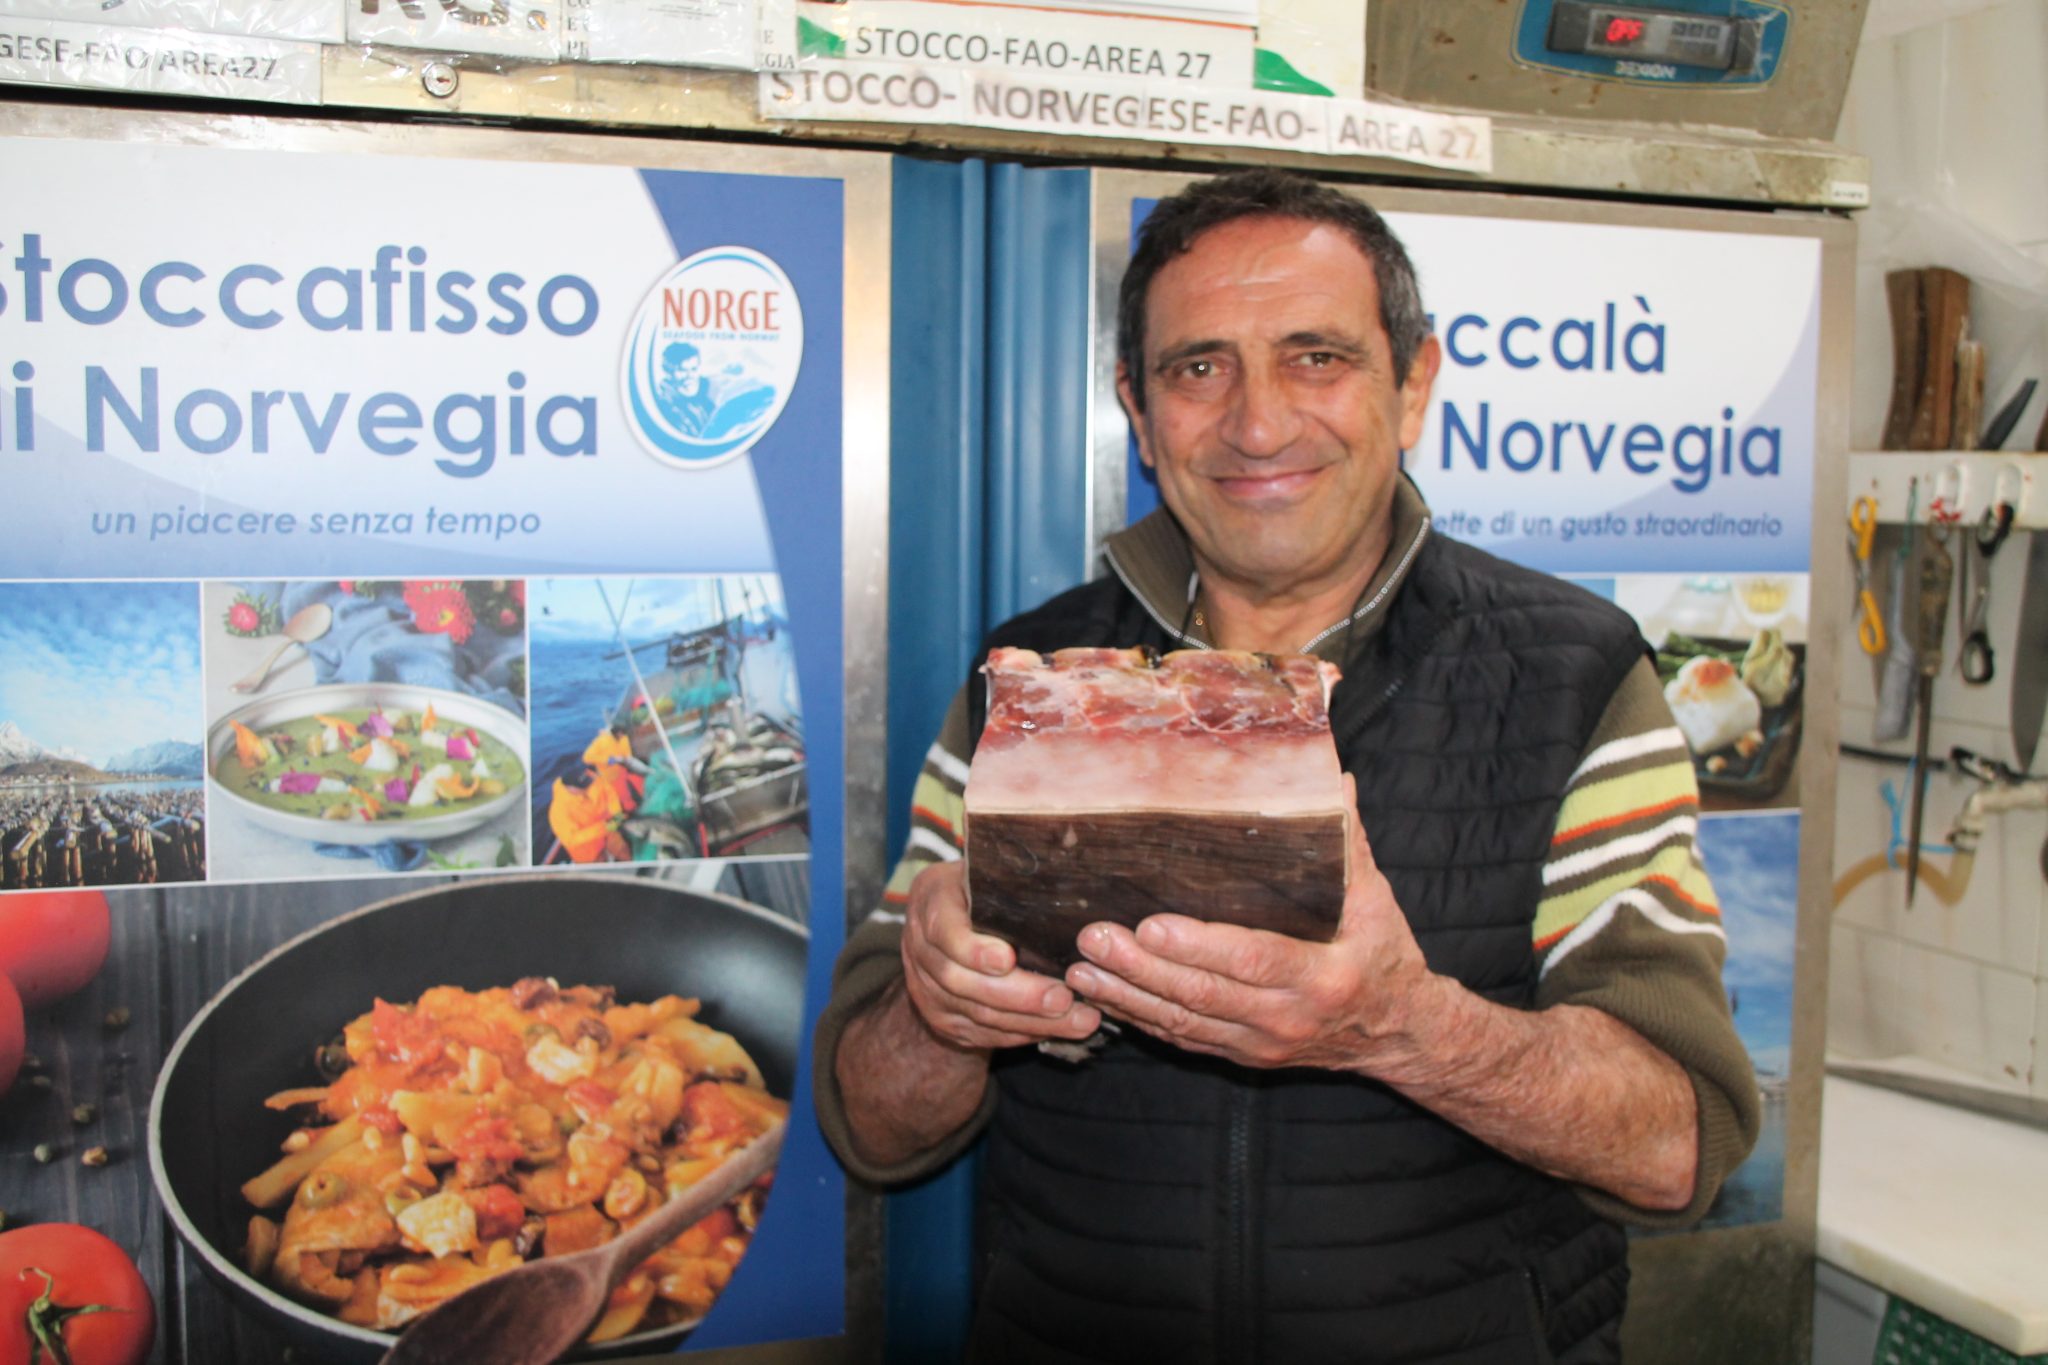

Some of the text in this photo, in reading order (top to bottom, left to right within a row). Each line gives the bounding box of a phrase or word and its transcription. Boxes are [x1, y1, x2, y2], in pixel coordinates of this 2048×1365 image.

[855, 26, 1212, 80] STOCCO-FAO-AREA 27
[771, 70, 1480, 161] STOCCO- NORVEGESE-FAO- AREA 27
[662, 288, 781, 331] NORGE
[1423, 295, 1666, 374] ccalà
[84, 364, 598, 479] Norvegia
[1441, 400, 1782, 493] Norvegia
[91, 505, 541, 541] un piacere senza tempo
[1491, 510, 1516, 535] di
[1522, 514, 1552, 536] un
[1560, 512, 1627, 542] gusto
[1634, 512, 1783, 537] straordinario
